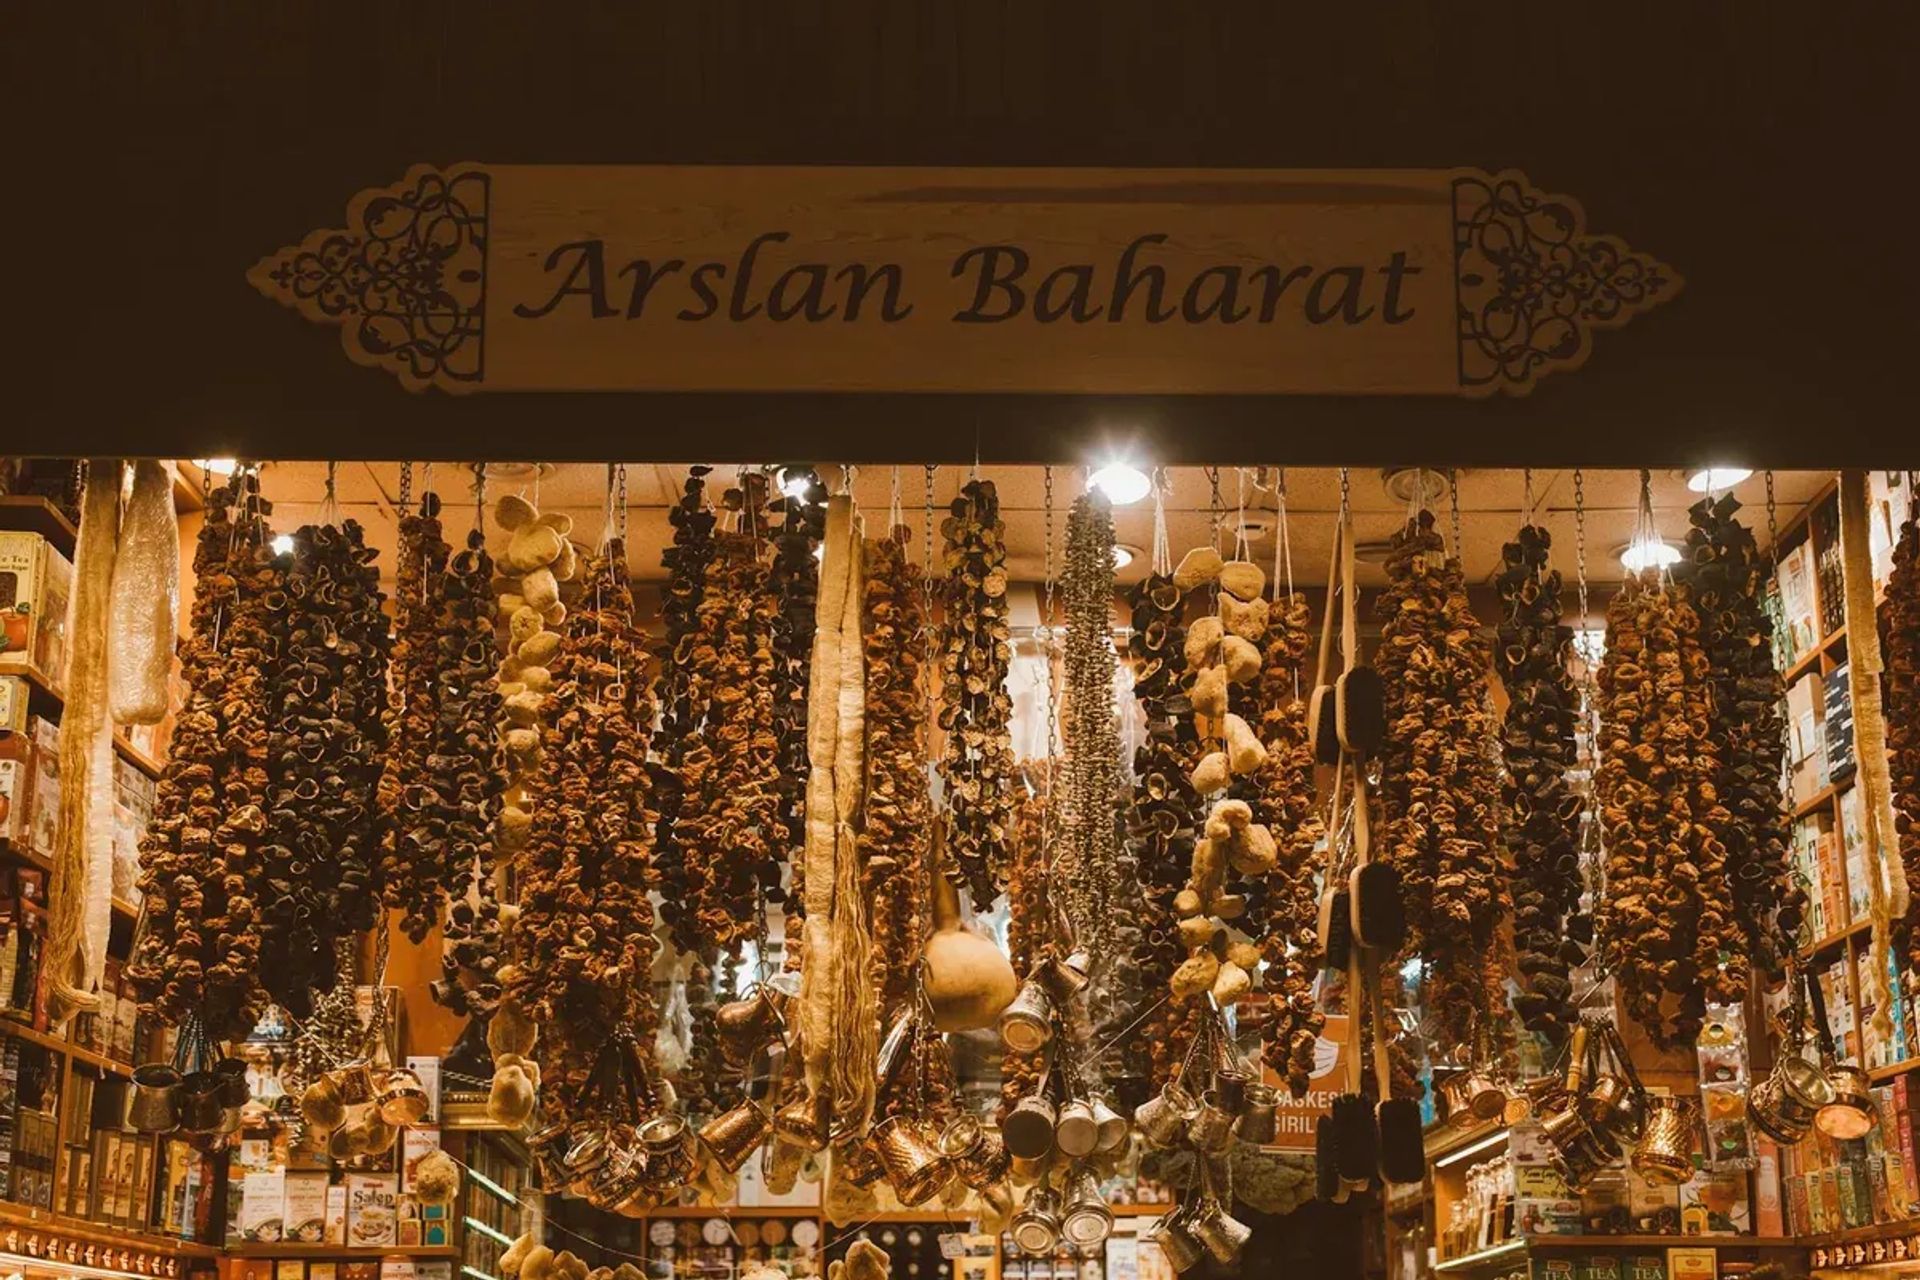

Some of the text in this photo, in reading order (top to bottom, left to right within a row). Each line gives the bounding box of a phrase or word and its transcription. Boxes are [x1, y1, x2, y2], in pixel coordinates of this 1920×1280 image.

[513, 231, 1423, 325] Arslan Baharat
[353, 1190, 394, 1206] Salep
[1586, 1267, 1617, 1280] TEA
[1632, 1267, 1663, 1280] TEA
